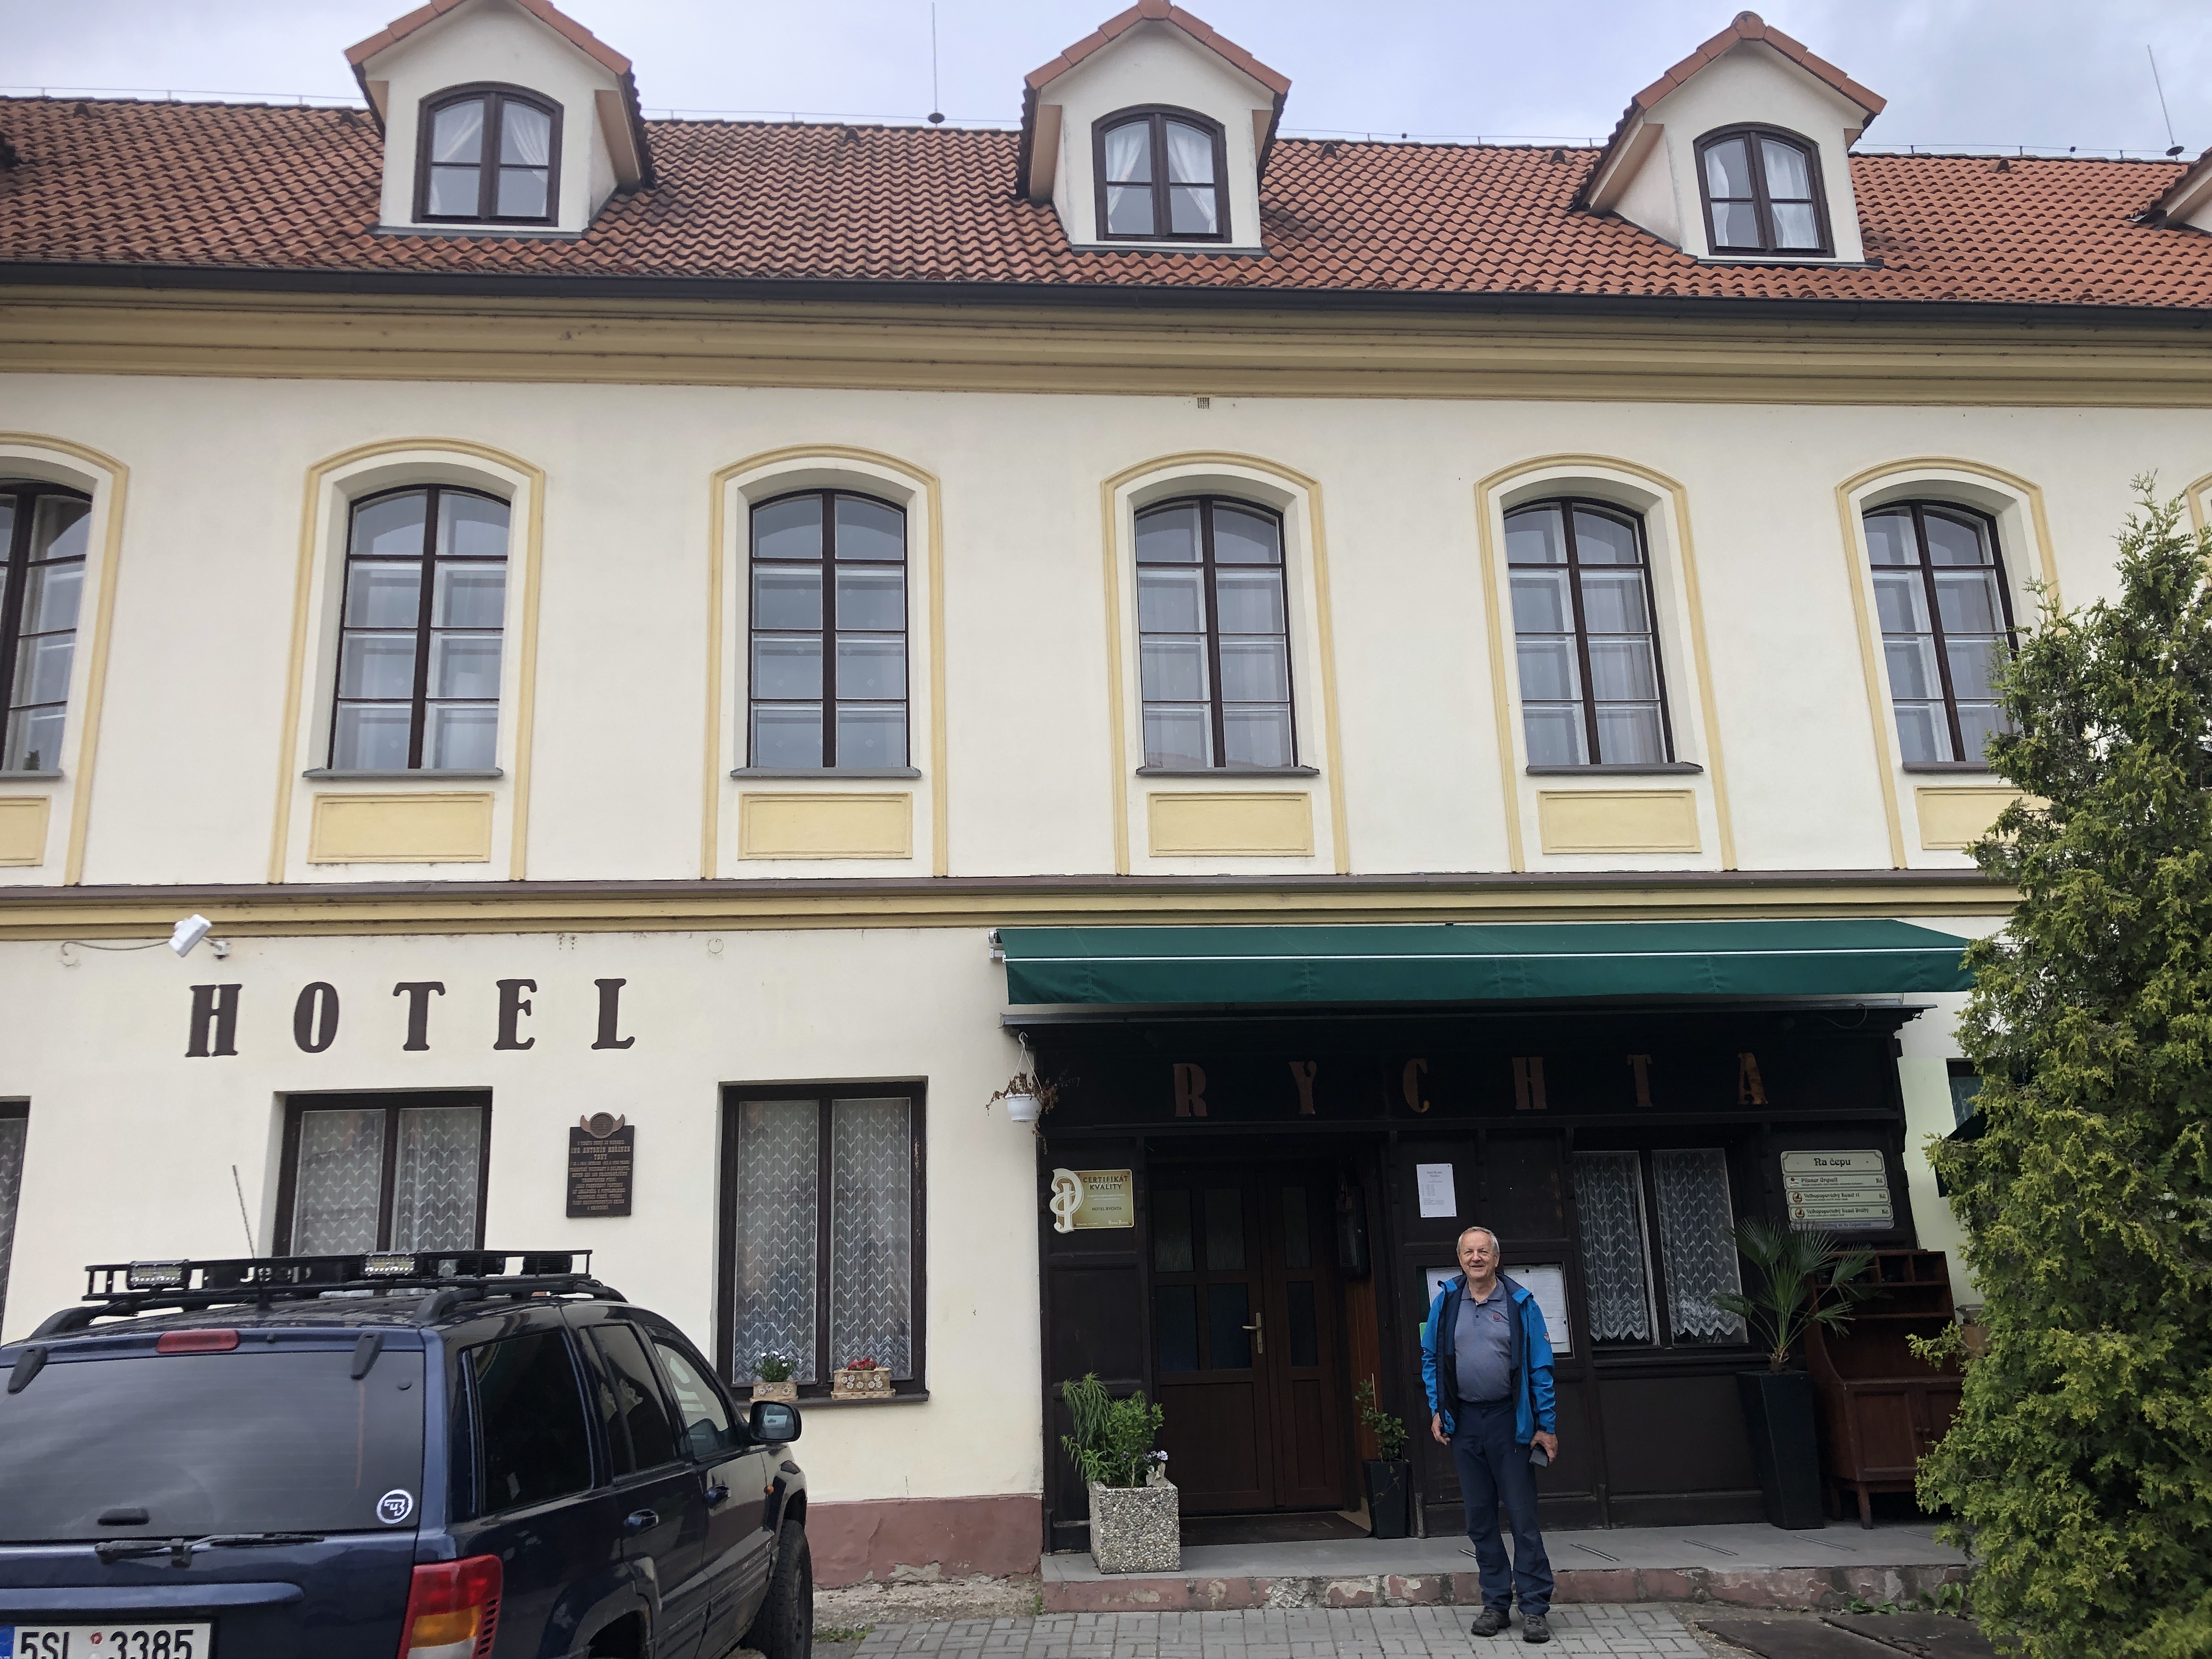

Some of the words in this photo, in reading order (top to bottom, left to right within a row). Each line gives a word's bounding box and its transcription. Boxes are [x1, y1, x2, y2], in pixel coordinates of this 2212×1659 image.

[185, 978, 635, 1058] HOTEL
[1172, 1052, 1768, 1117] RYCHTA
[1083, 1174, 1128, 1183] CERTIFIKÁT
[1814, 1158, 1827, 1166] Na
[1830, 1157, 1851, 1167] čepu
